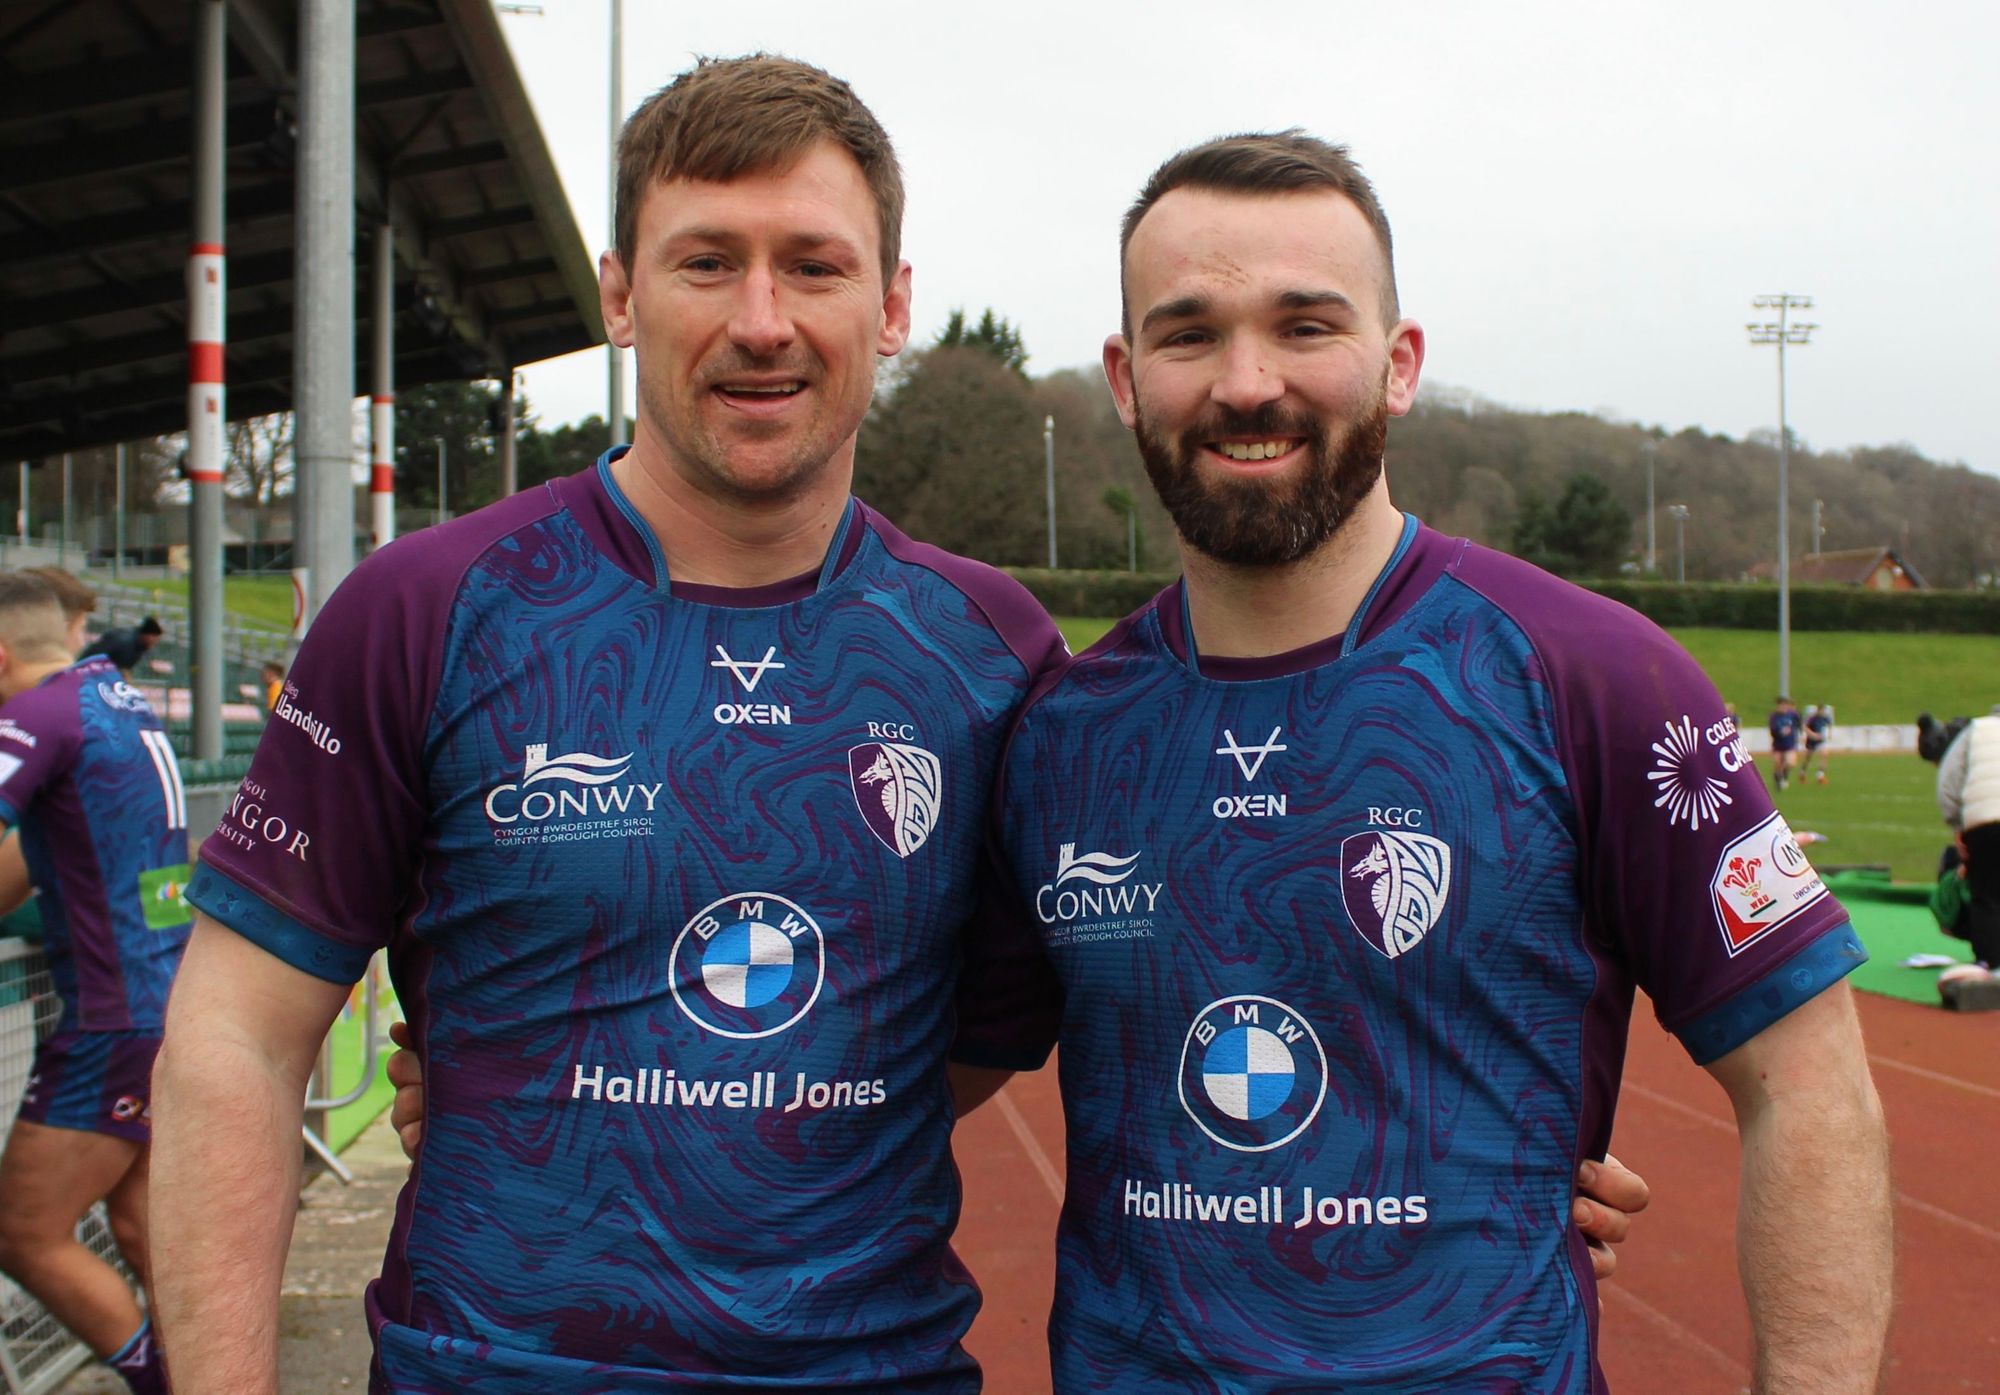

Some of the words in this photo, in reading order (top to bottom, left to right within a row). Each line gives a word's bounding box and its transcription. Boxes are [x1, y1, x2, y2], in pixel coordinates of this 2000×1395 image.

[713, 703, 792, 725] OXEN
[867, 721, 914, 741] RGC
[139, 730, 187, 829] 11
[485, 783, 663, 823] CONWY
[1212, 794, 1287, 819] OXEN
[226, 792, 310, 861] NGOR
[494, 827, 540, 837] CYNGOR
[543, 820, 620, 834] BWRDEISTREF
[623, 818, 655, 827] SIROL
[1367, 806, 1422, 828] RGC
[494, 837, 539, 847] COUNTY
[541, 831, 600, 844] BOROUGH
[602, 827, 655, 838] COUNCIL
[1036, 882, 1163, 924] CONWY
[1749, 894, 1770, 910] WRU
[693, 899, 811, 942] BMW
[1072, 919, 1126, 934] BWRDEISTREF
[1128, 918, 1155, 929] SIROL
[1072, 931, 1112, 944] BOROUGH
[1113, 927, 1155, 940] COUNCIL
[1194, 1003, 1305, 1047] BMW
[571, 1064, 776, 1108] Halliwell
[784, 1072, 886, 1113] Jones
[1124, 1179, 1283, 1223] Halliwell
[1294, 1187, 1428, 1229] Jones
